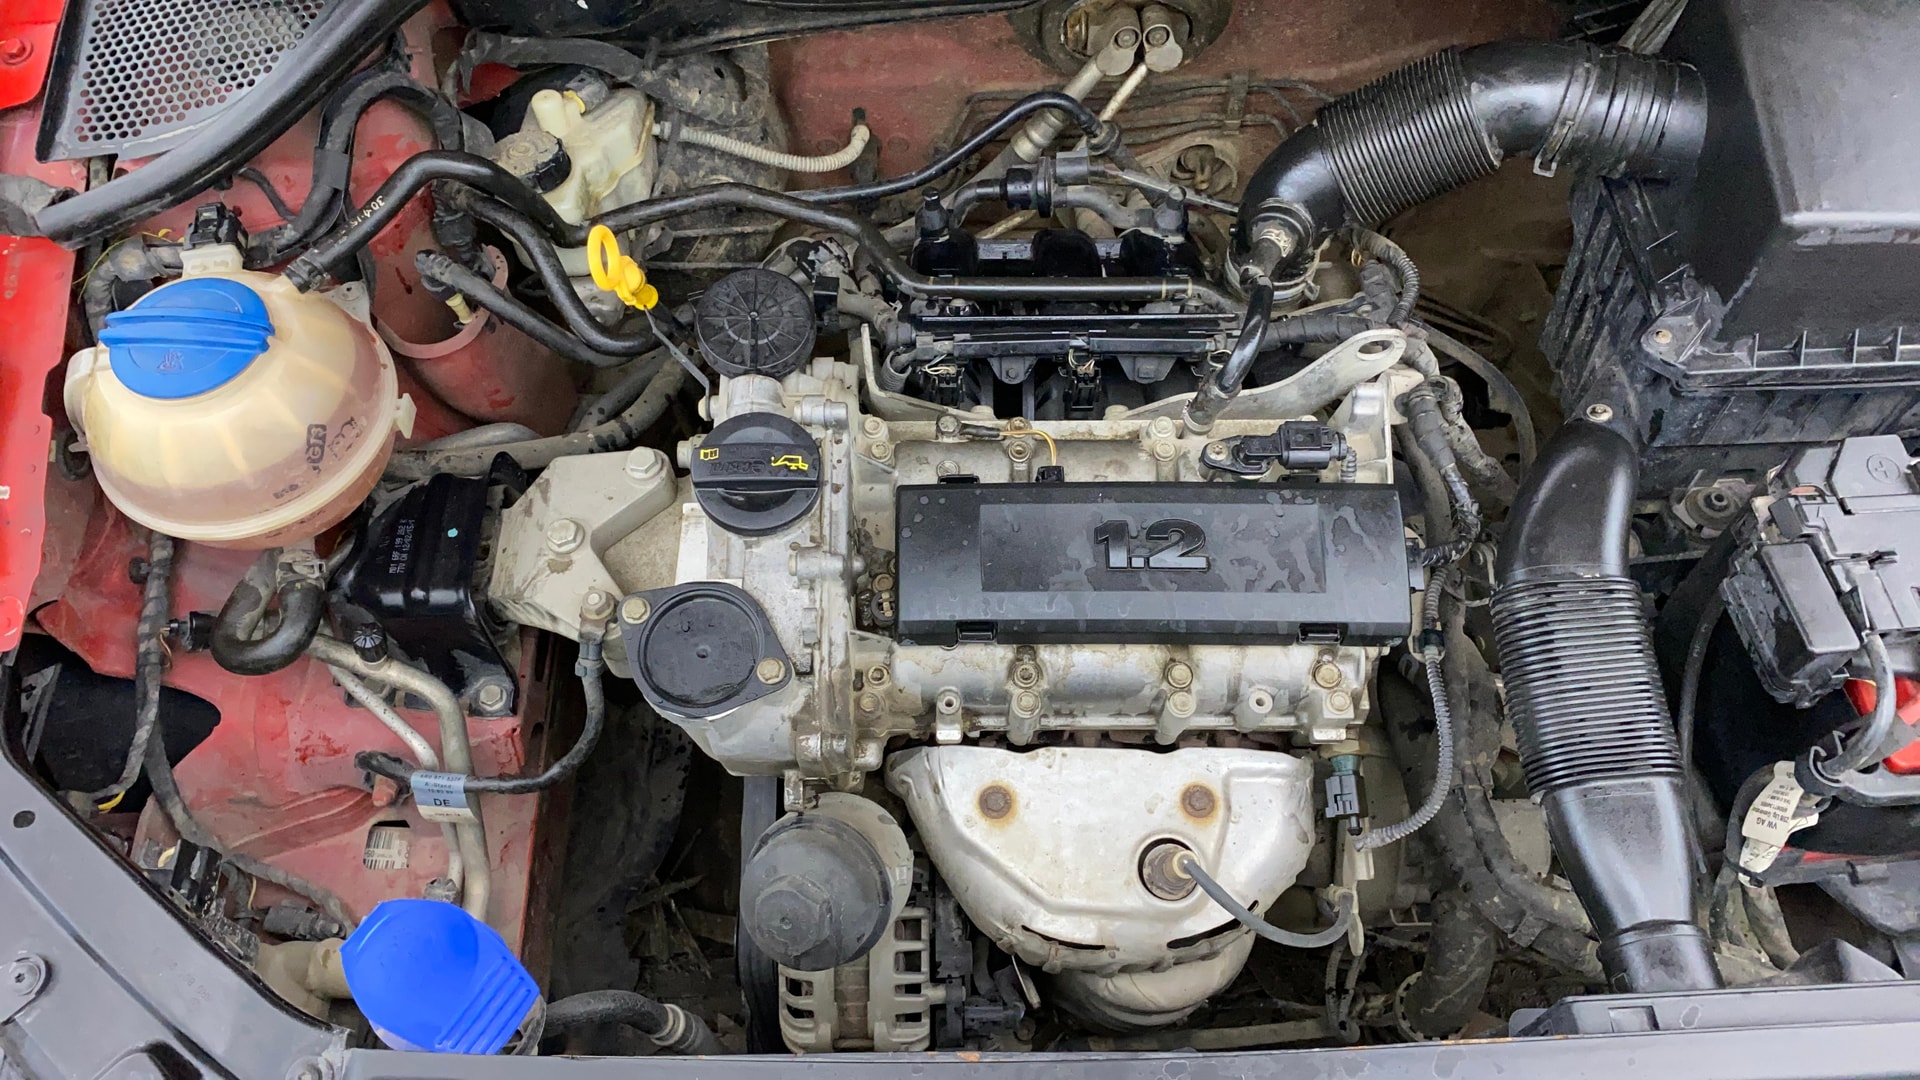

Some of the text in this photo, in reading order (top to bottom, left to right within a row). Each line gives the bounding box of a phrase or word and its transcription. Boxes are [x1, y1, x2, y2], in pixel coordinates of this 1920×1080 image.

[1094, 518, 1211, 572] 1.2
[433, 798, 451, 807] DE
[1755, 817, 1778, 830] VW AG
